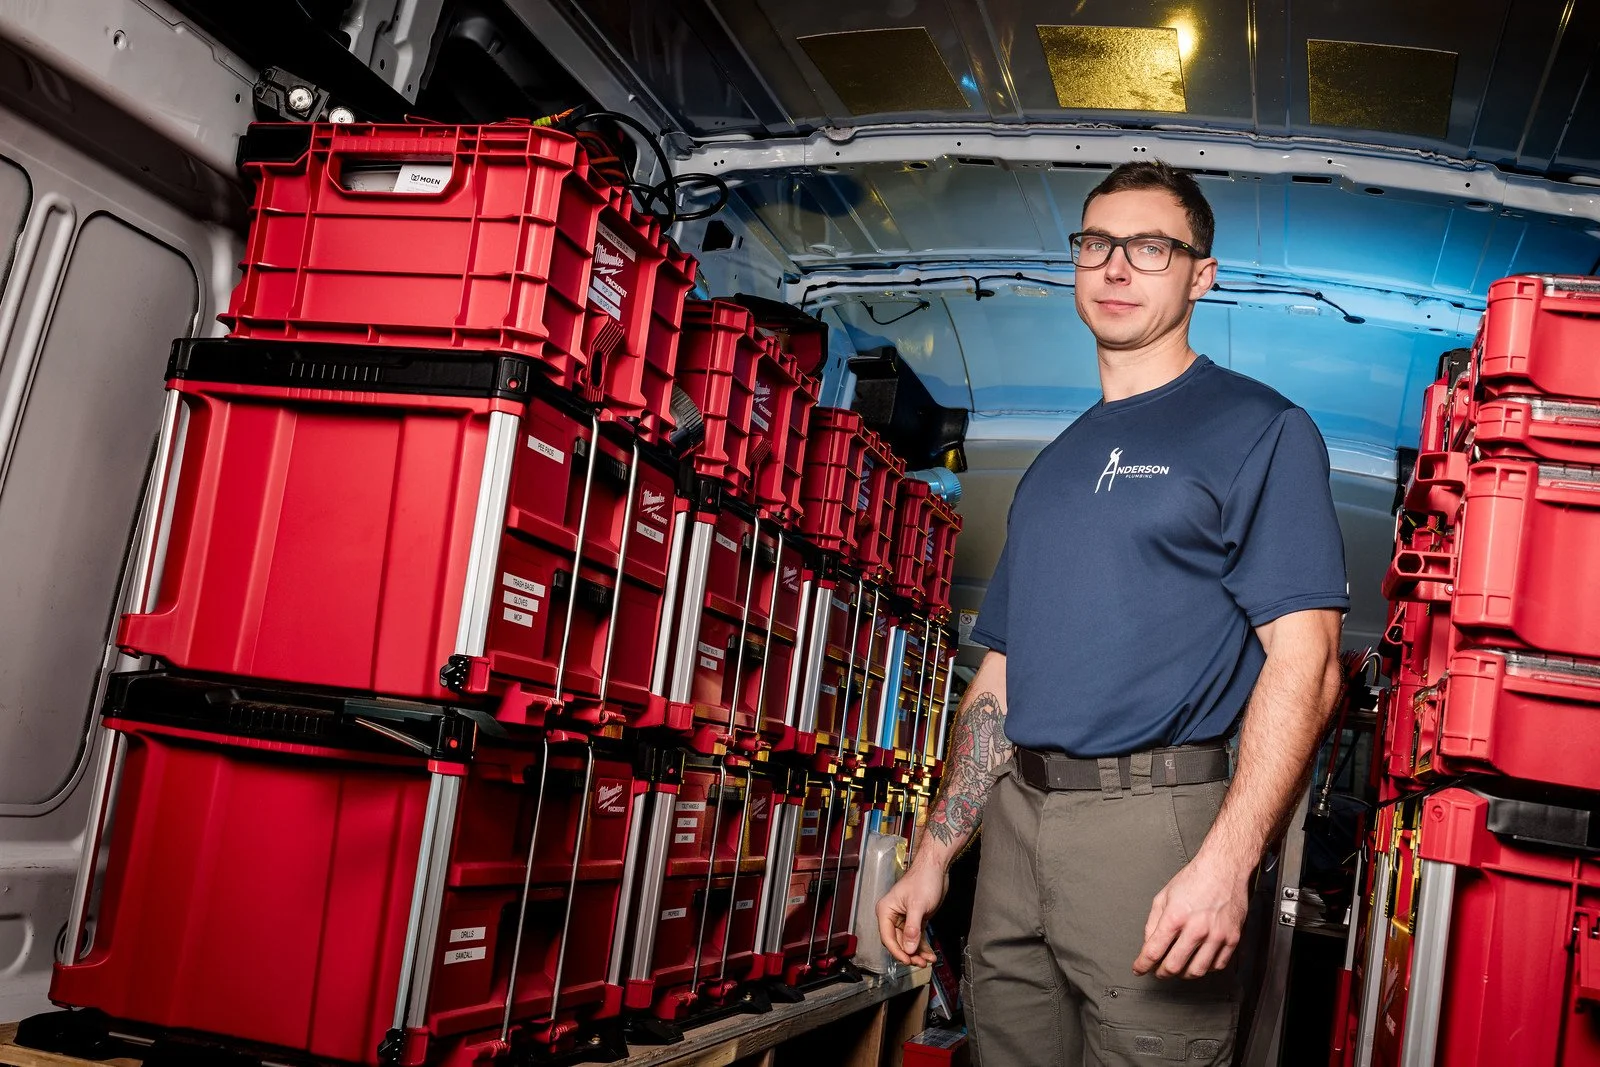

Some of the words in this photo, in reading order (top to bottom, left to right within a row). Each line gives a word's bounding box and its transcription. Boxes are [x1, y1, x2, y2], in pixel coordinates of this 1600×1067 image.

[420, 176, 440, 185] MOEN
[595, 242, 624, 267] Milwaukee
[606, 276, 627, 298] PACKOUT
[1095, 447, 1170, 494] ANDERSON
[513, 596, 529, 607] GLOVES
[513, 613, 523, 621] MOP
[460, 930, 475, 939] DRILLS
[455, 951, 473, 960] SAWZALL
